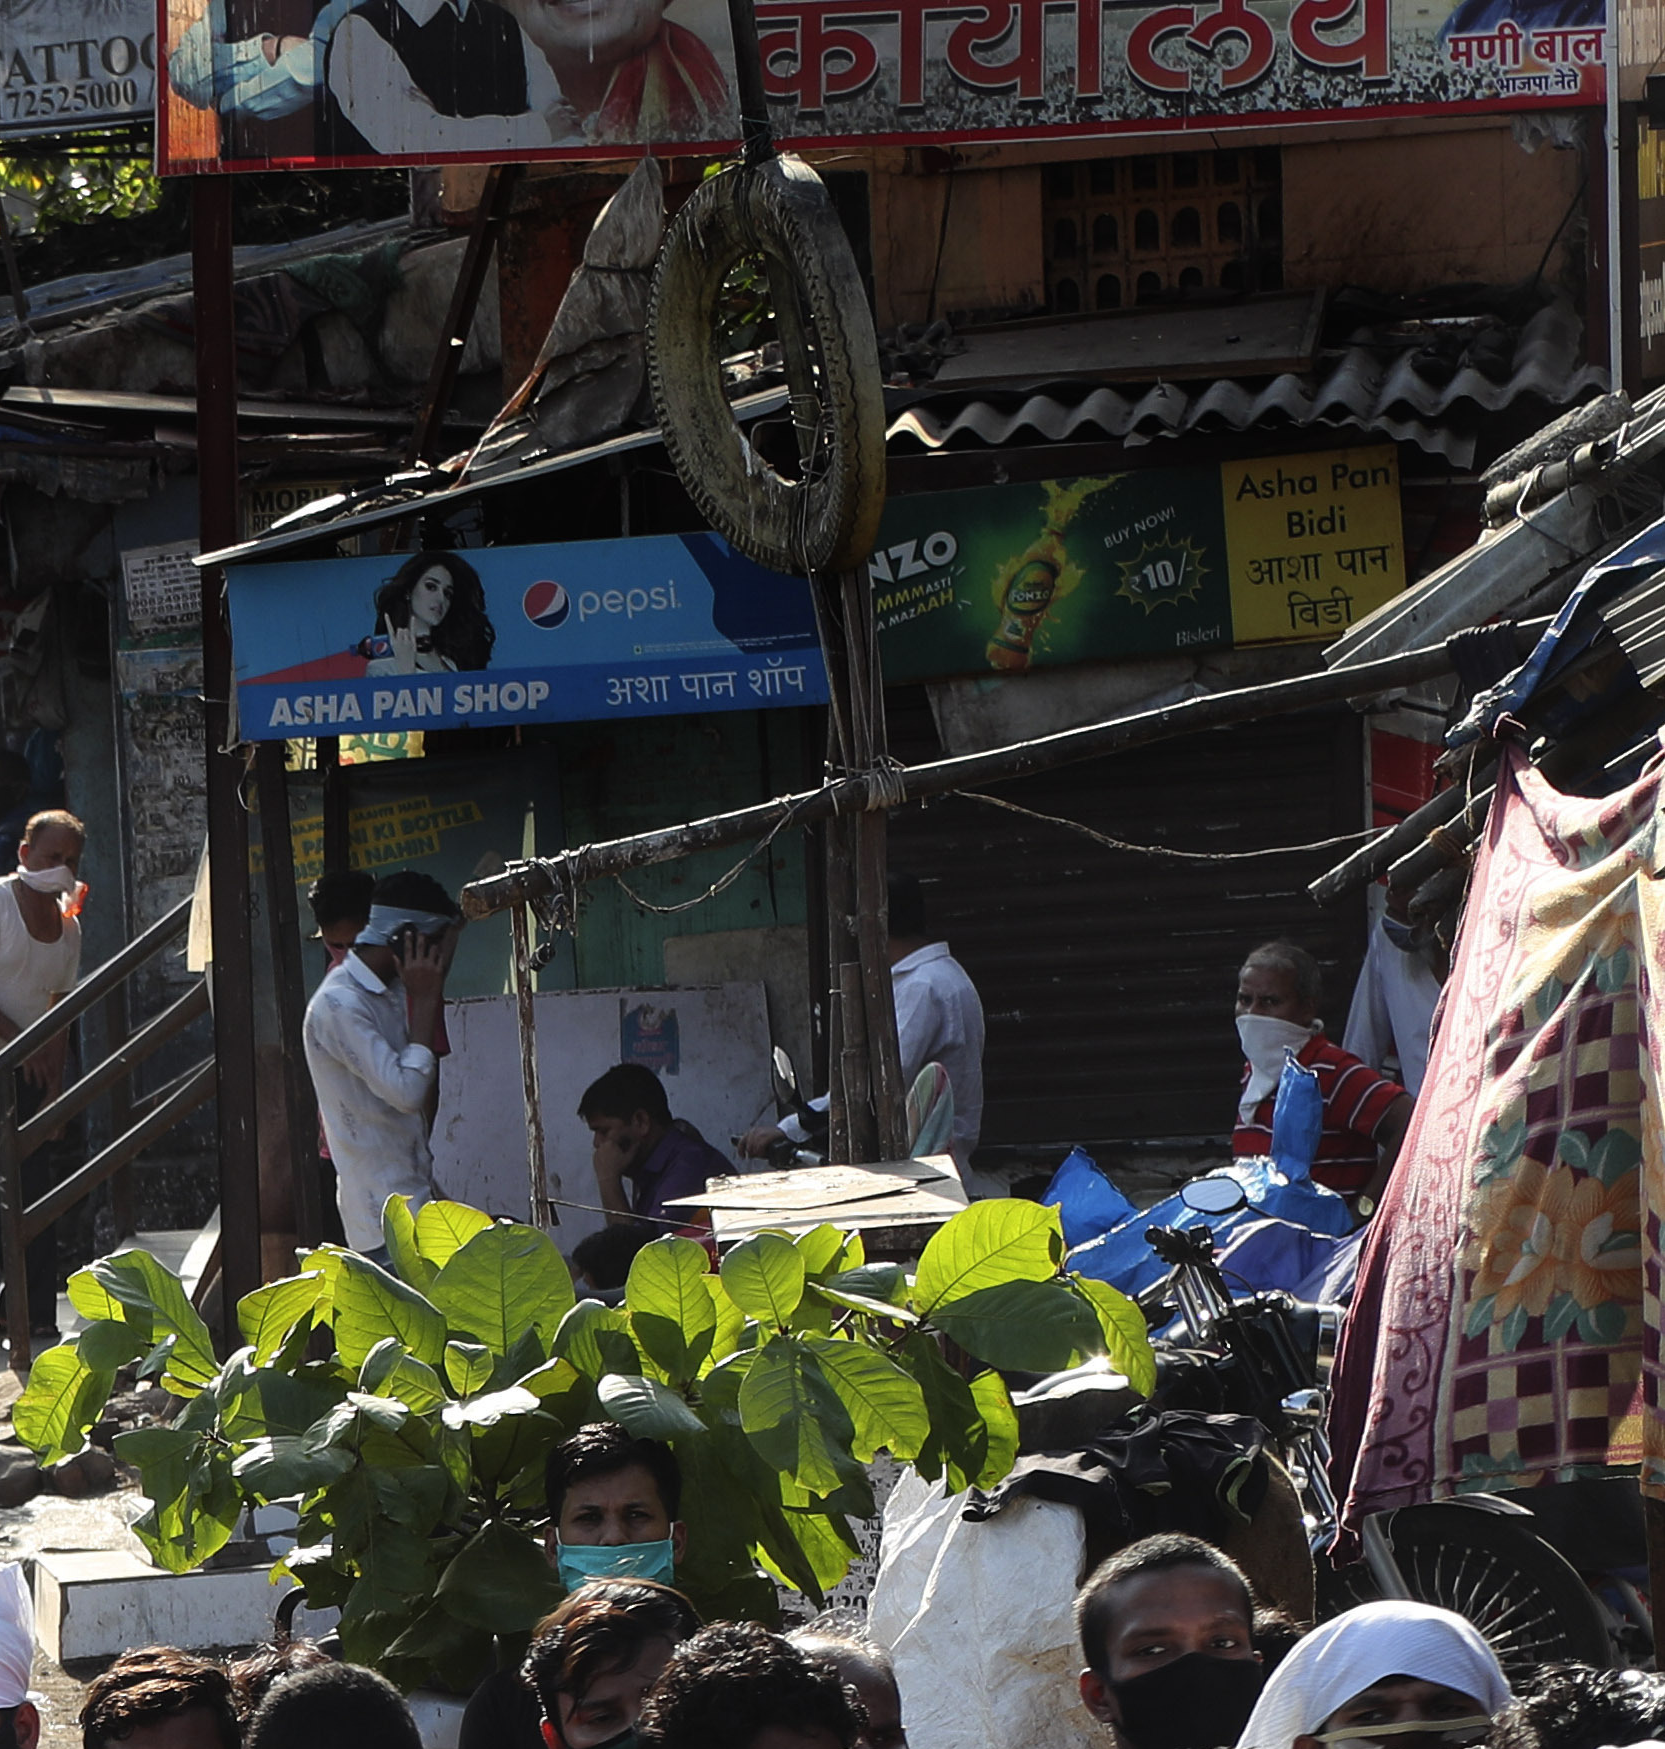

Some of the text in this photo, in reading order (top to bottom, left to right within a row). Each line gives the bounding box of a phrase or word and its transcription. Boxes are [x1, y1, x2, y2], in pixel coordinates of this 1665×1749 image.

[1449, 24, 1521, 68] मणी
[1531, 25, 1604, 64] बाल
[1496, 68, 1579, 94] भाजपा नेते
[1236, 463, 1390, 502] Asha Pan
[1103, 505, 1176, 550] BUY NOW!
[1287, 505, 1346, 538] Bidi
[1246, 545, 1390, 585] आशा पान
[578, 579, 676, 623] pepsi
[1175, 625, 1221, 647] Bisleri
[605, 657, 806, 707] अशा पान शॉप
[269, 680, 550, 727] ASHA PAN SHOP
[373, 823, 397, 839] KI
[402, 805, 474, 834] BOTTLE
[365, 835, 435, 864] NAHIN
